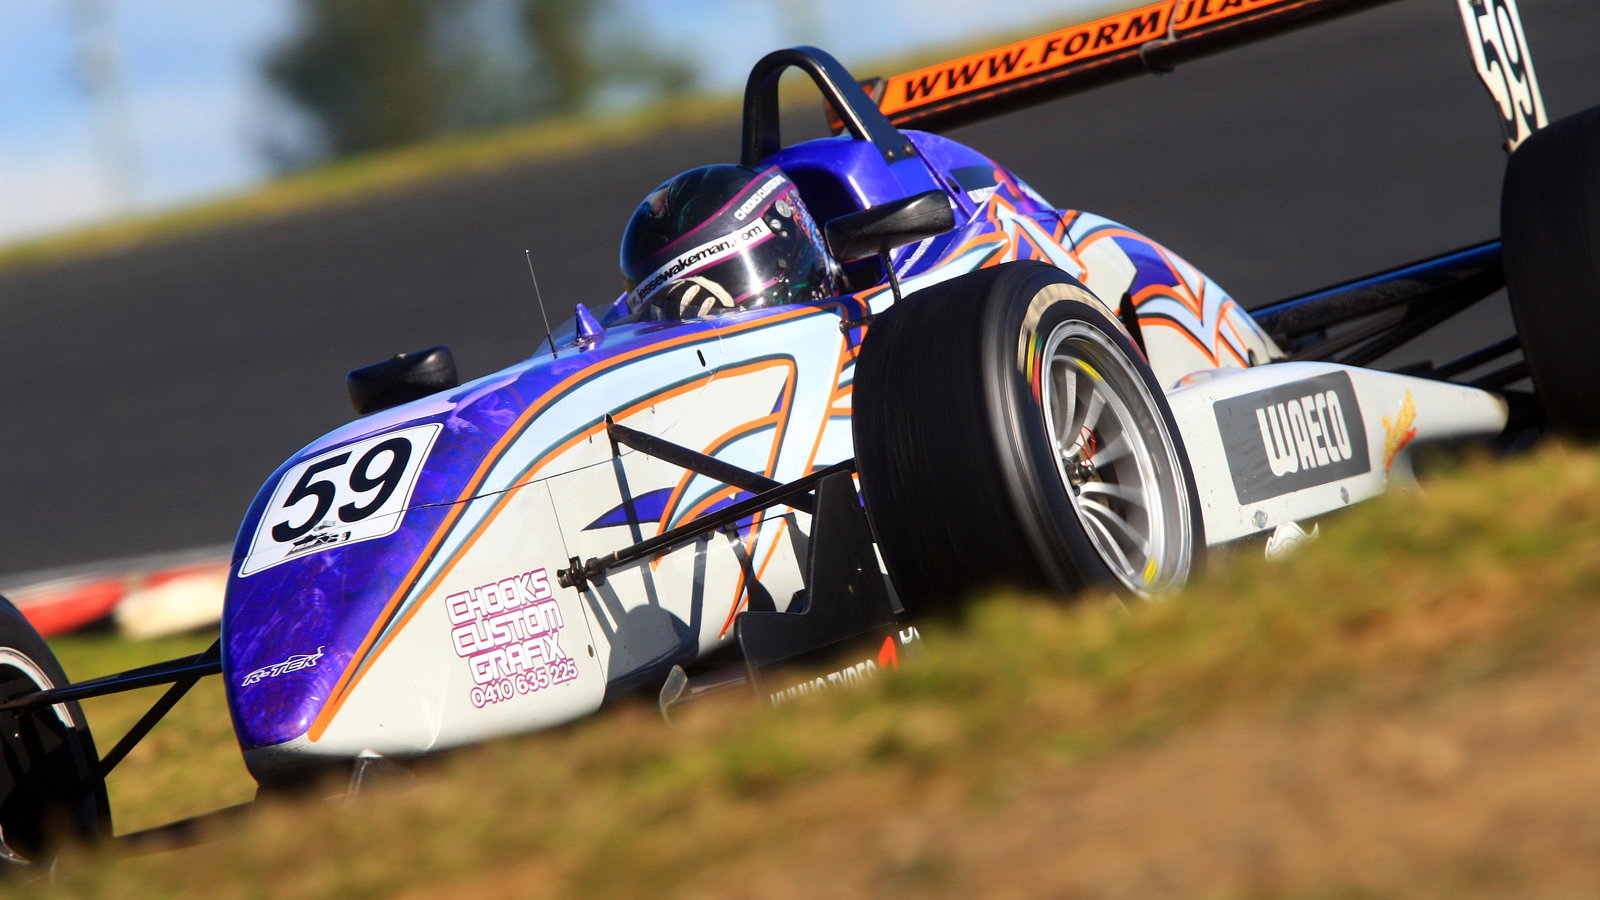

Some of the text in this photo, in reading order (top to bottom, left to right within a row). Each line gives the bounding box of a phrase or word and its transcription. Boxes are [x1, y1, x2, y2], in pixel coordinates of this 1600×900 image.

[1472, 0, 1538, 142] 59
[636, 225, 762, 304] jessewakeman.om
[1256, 390, 1352, 477] WAECO
[272, 437, 412, 542] 59
[445, 568, 552, 625] CHOOKS
[451, 598, 564, 658] CUSTOM
[468, 630, 566, 685] GRAFIX
[470, 658, 578, 708] 0410 635 225
